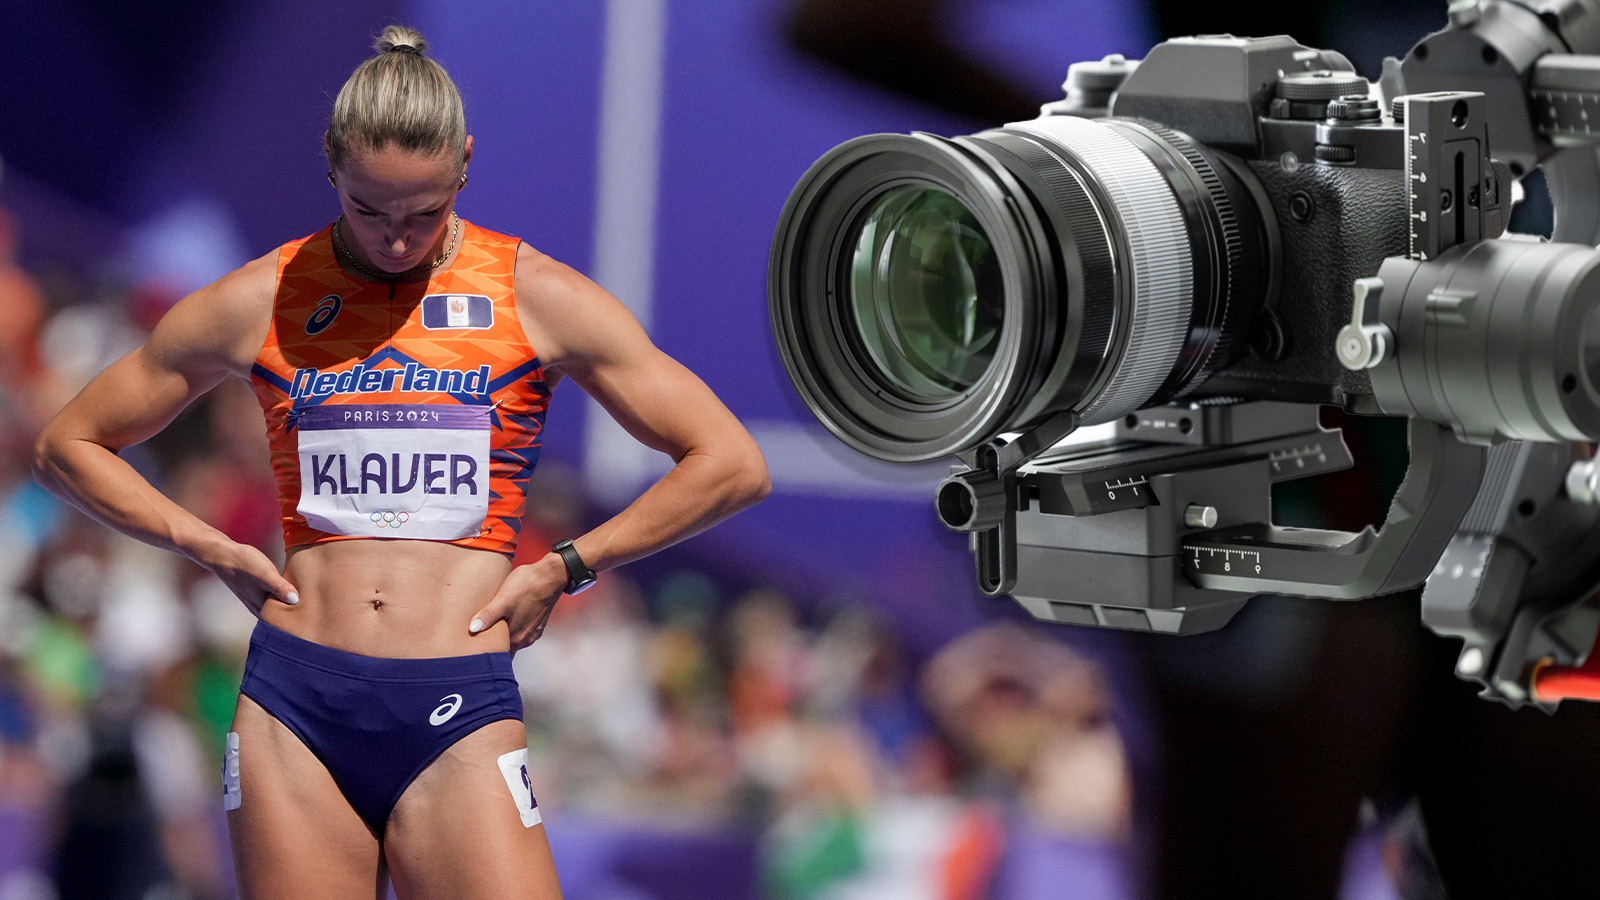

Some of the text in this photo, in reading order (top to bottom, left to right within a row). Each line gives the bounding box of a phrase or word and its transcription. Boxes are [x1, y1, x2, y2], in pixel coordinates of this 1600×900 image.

[344, 410, 439, 422] PARIS 2024
[311, 453, 478, 496] KLAVER
